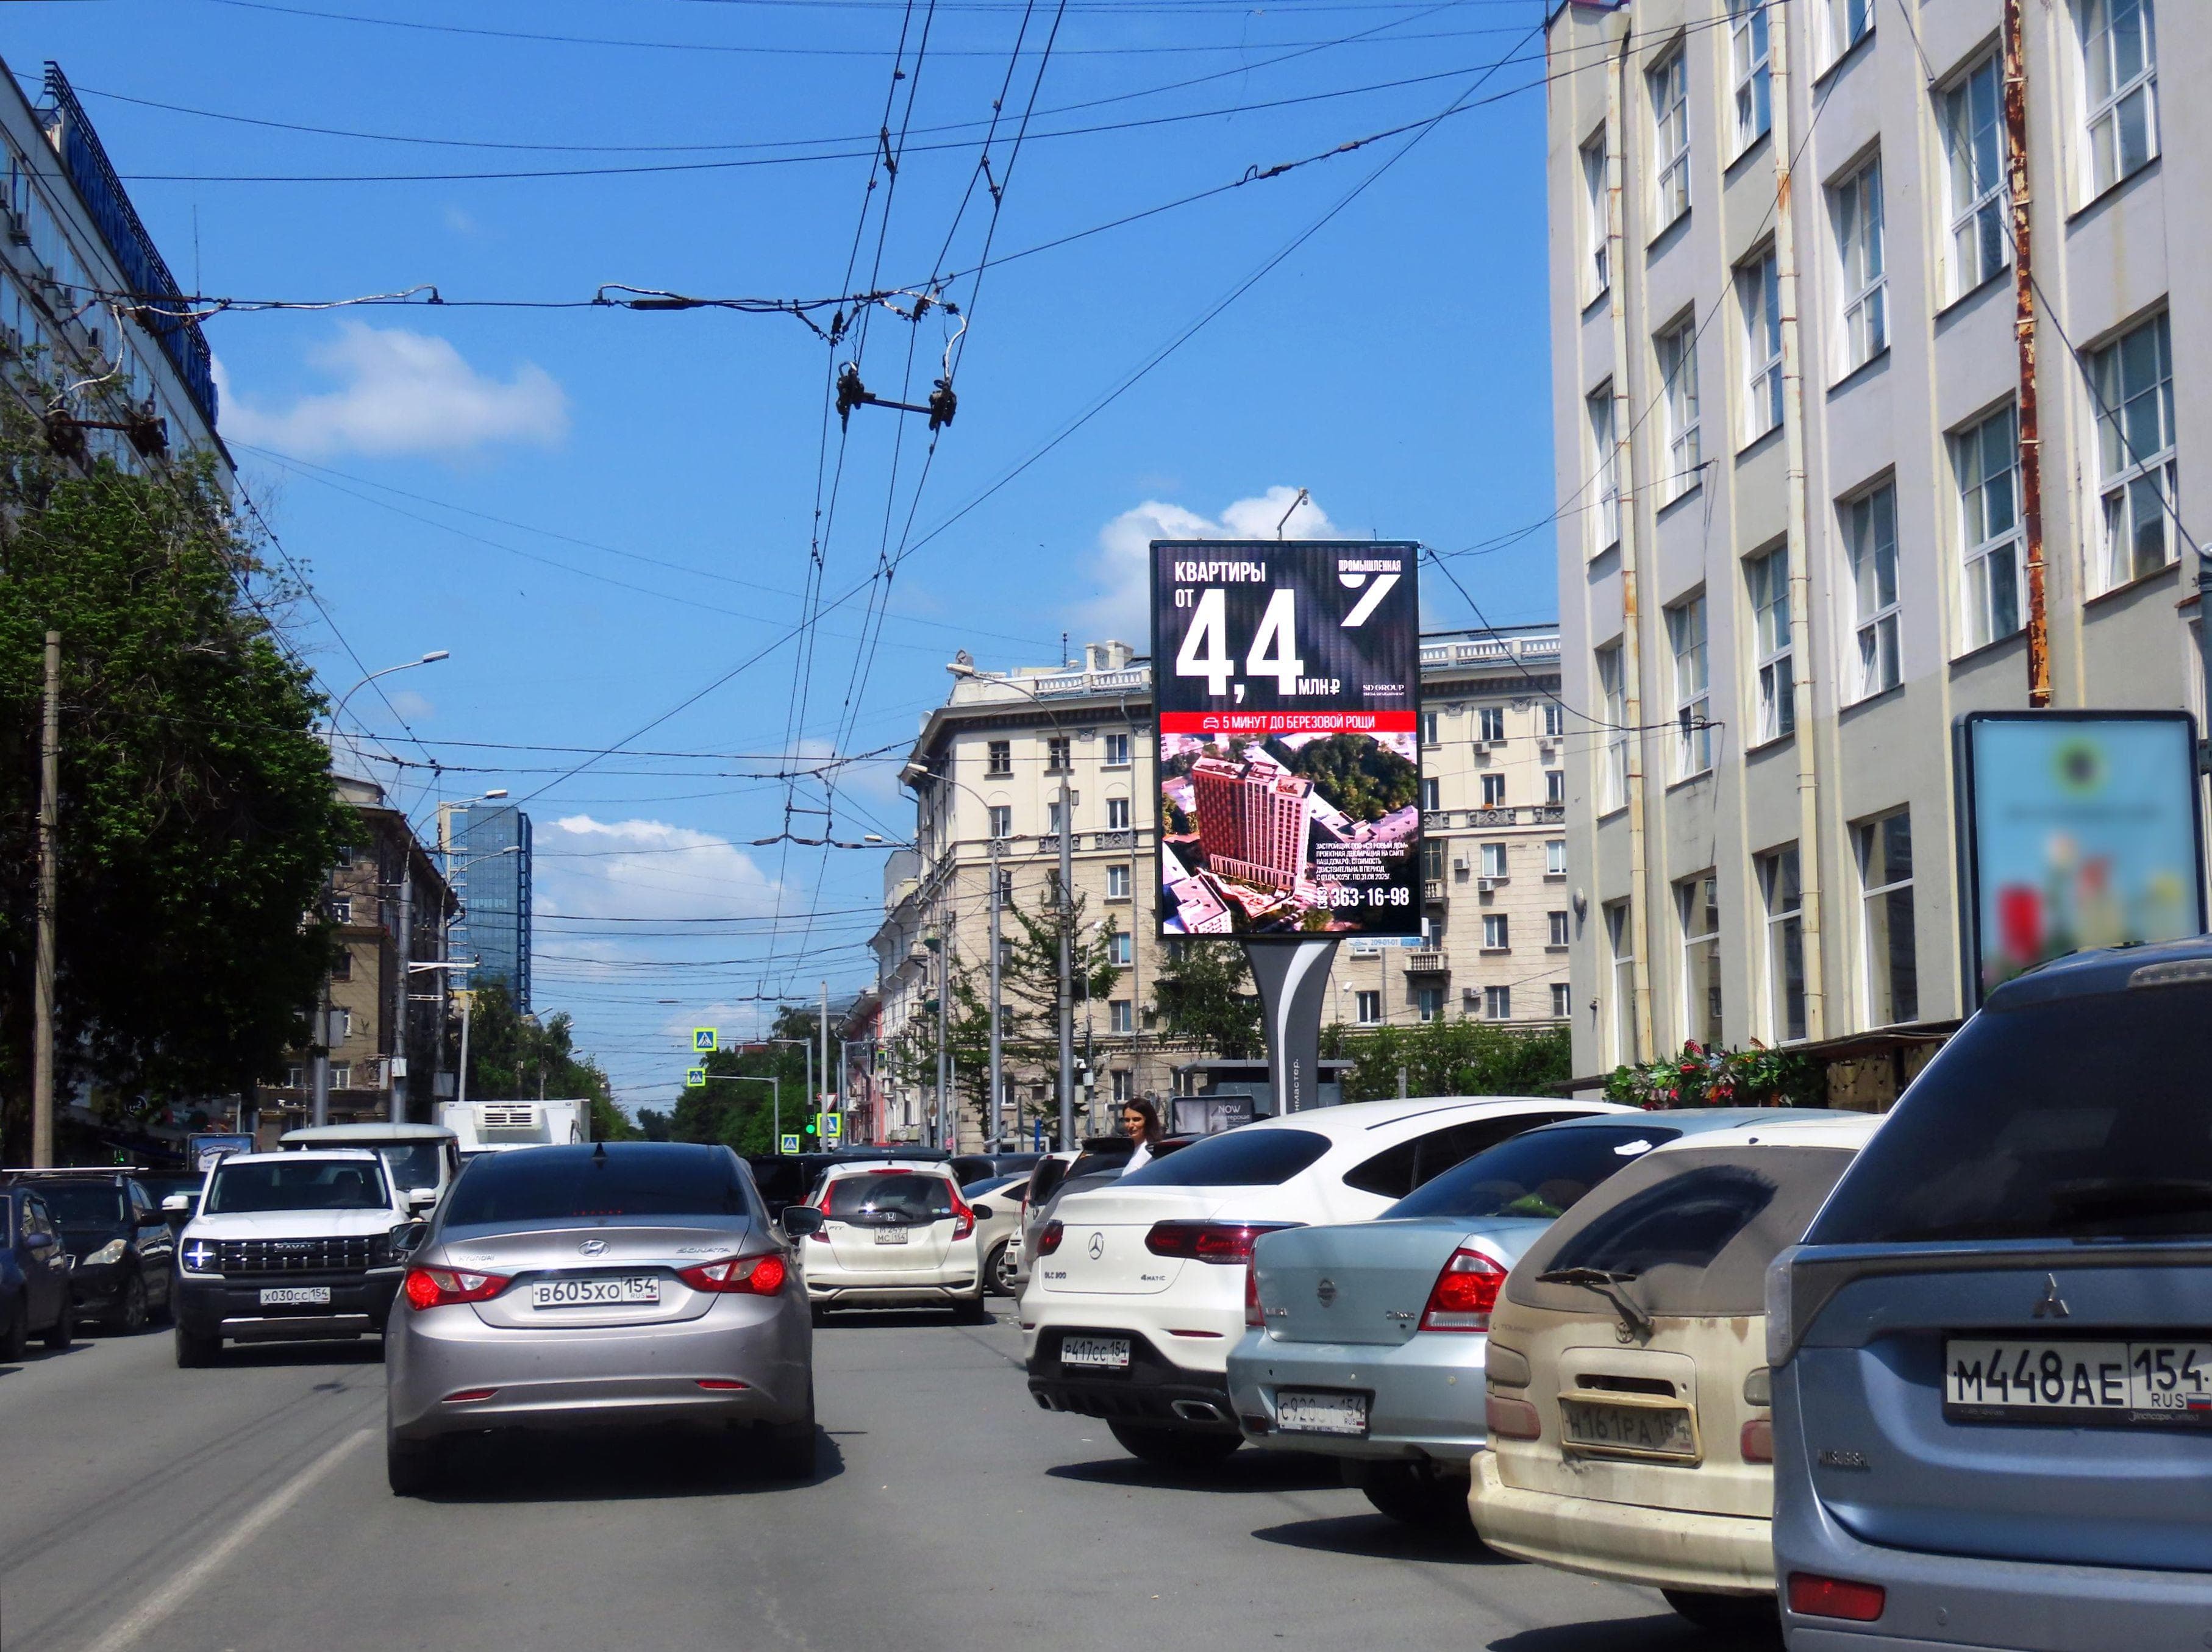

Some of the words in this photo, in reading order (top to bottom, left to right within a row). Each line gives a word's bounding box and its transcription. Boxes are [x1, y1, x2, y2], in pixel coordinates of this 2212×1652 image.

[1175, 561, 1266, 582] КВАРТИРЫ
[1338, 560, 1401, 572] ПРОМЫШЛЕННАЯ
[1175, 588, 1194, 608] ОТ
[1176, 588, 1304, 704] 4,4
[1222, 716, 1230, 728] 5
[1232, 716, 1268, 728] МИНУТ
[1269, 716, 1284, 730] ДО
[1286, 713, 1343, 728] БЕРЕЗОВОЙ
[1346, 716, 1375, 730] РОЩИ
[1330, 887, 1410, 907] 363-16-98
[1218, 1105, 1241, 1114] NOW
[458, 1253, 494, 1262] HYUNDAI
[264, 1289, 308, 1301] Х030СС
[310, 1288, 327, 1297] 154
[540, 1281, 620, 1303] В605ХО
[624, 1277, 654, 1294] 154
[1065, 1340, 1107, 1361] Р417СС
[1110, 1340, 1127, 1358] 154
[1957, 1348, 2124, 1406] М448АЕ
[2133, 1349, 2202, 1392] 154
[2152, 1393, 2185, 1408] RUS
